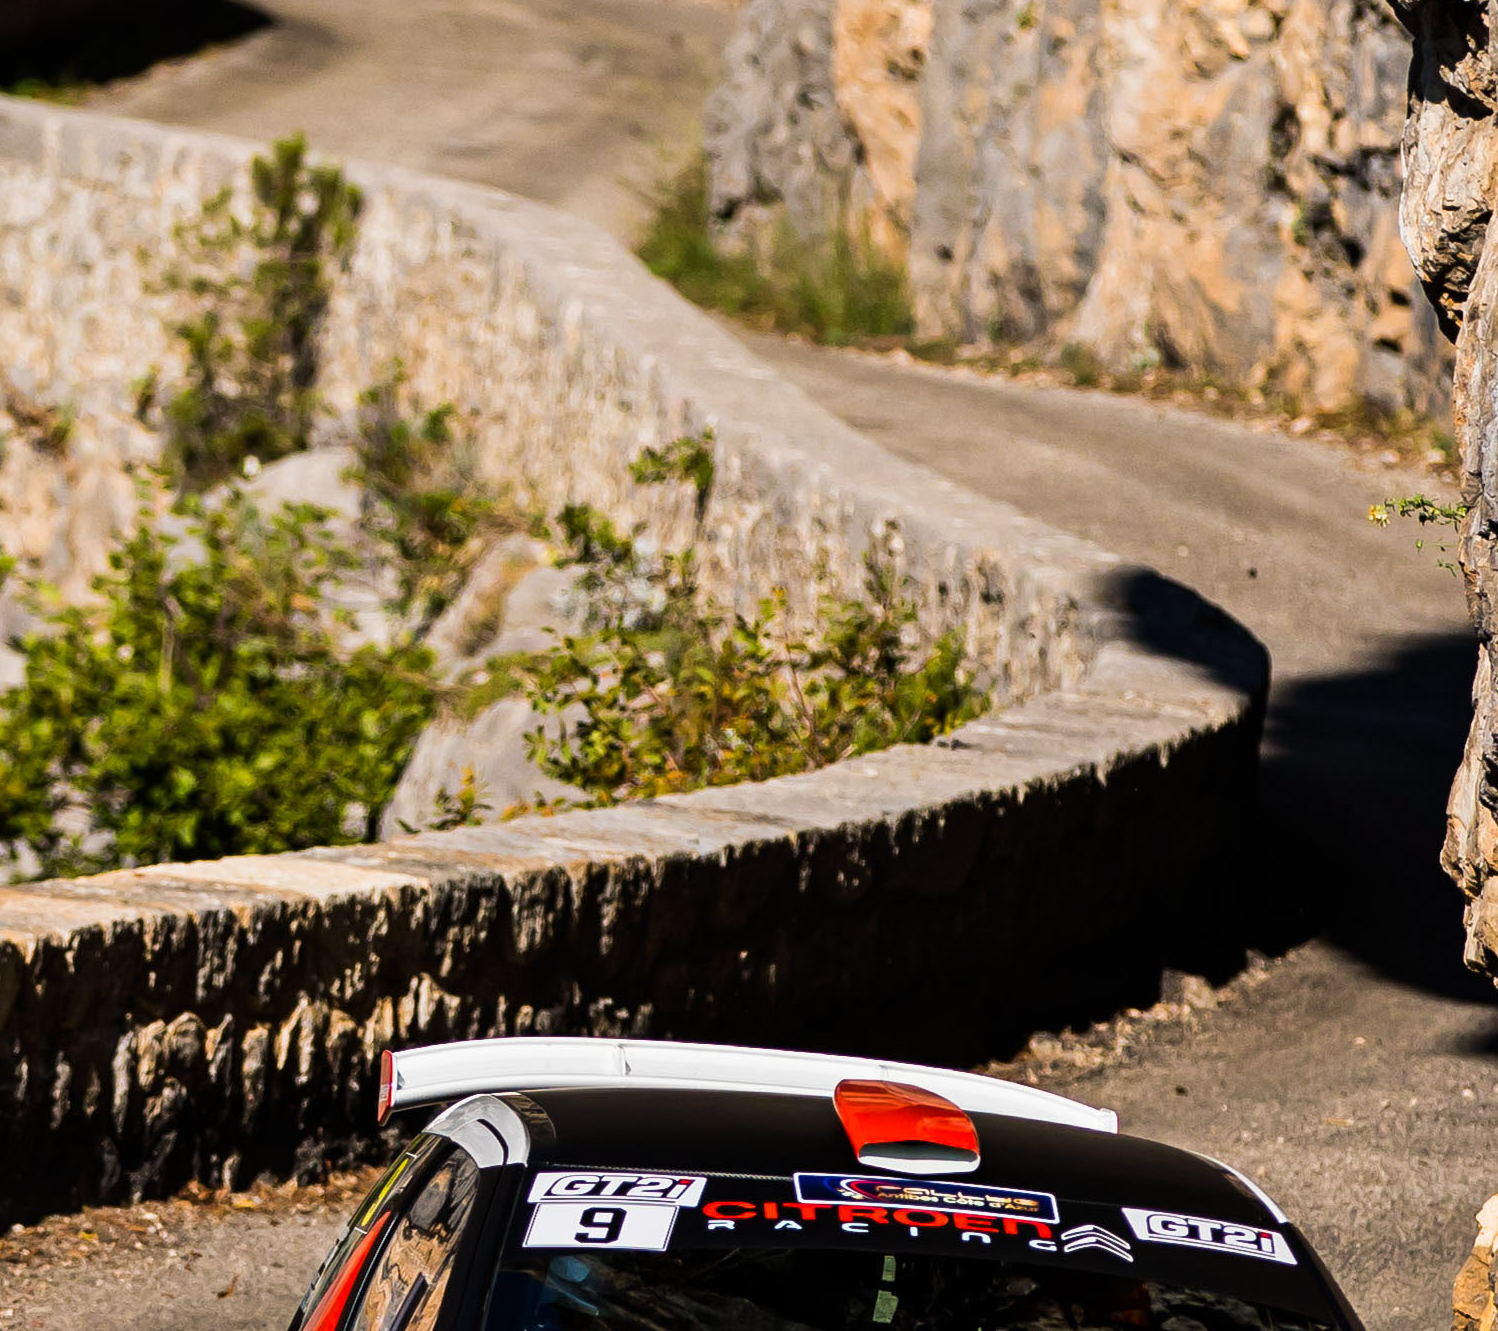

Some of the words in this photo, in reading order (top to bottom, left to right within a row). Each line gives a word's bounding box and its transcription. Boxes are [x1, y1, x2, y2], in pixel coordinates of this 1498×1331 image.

[550, 1175, 690, 1199] GT2i
[877, 1192, 939, 1204] Antibes
[574, 1207, 627, 1244] 9
[707, 1219, 1057, 1252] RACING
[1149, 1215, 1274, 1253] GT2i
